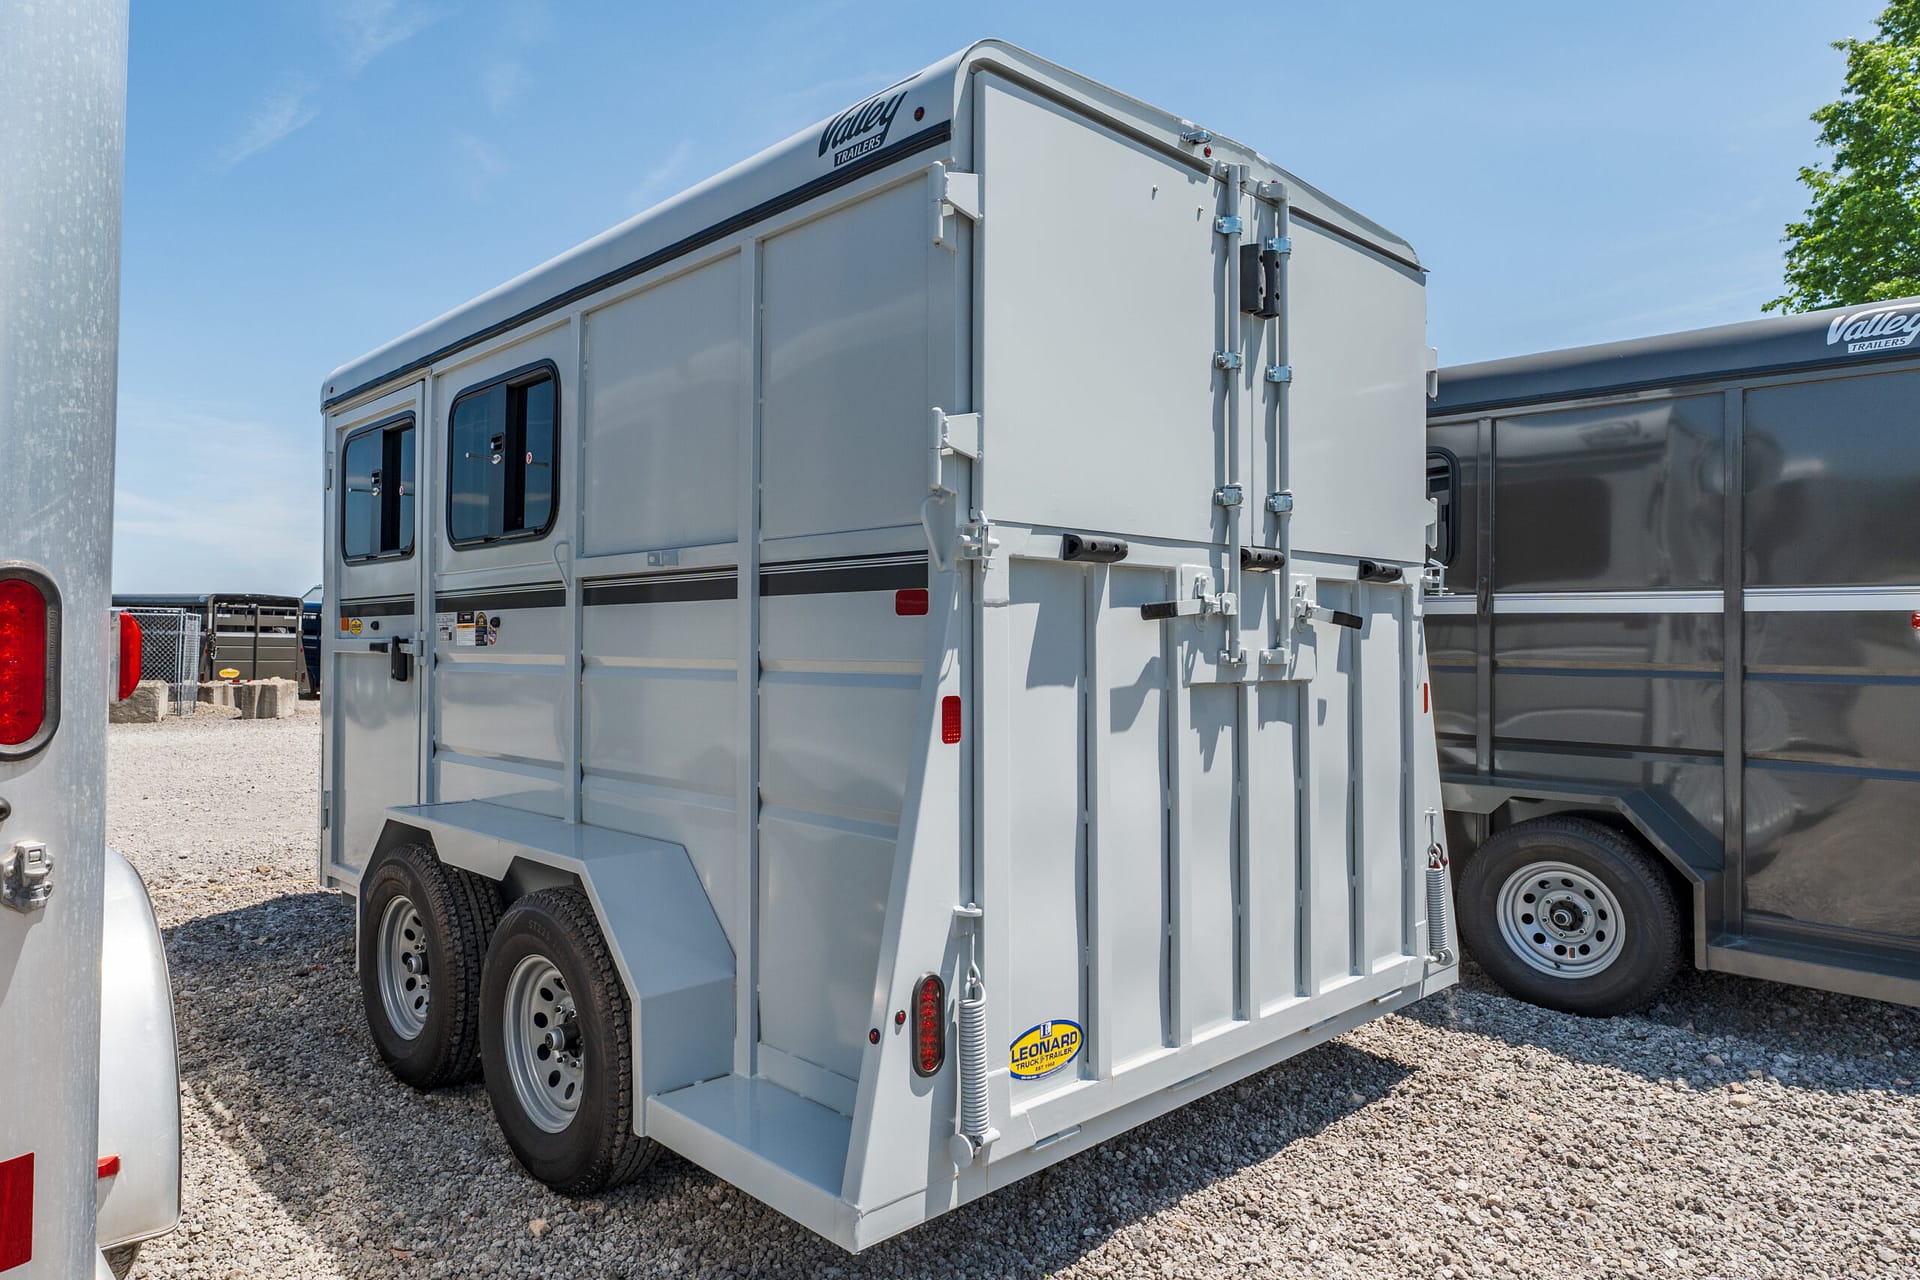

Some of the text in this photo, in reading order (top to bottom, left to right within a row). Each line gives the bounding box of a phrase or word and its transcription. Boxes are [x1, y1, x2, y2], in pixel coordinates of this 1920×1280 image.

[818, 88, 908, 158] Valley
[836, 134, 881, 166] TRAILERS
[1827, 308, 1920, 346] Valley
[1851, 337, 1906, 352] TRAILERS
[1011, 1031, 1078, 1064] LEONARD
[1016, 1058, 1039, 1071] TRUCK
[1045, 1047, 1073, 1062] TRAILER
